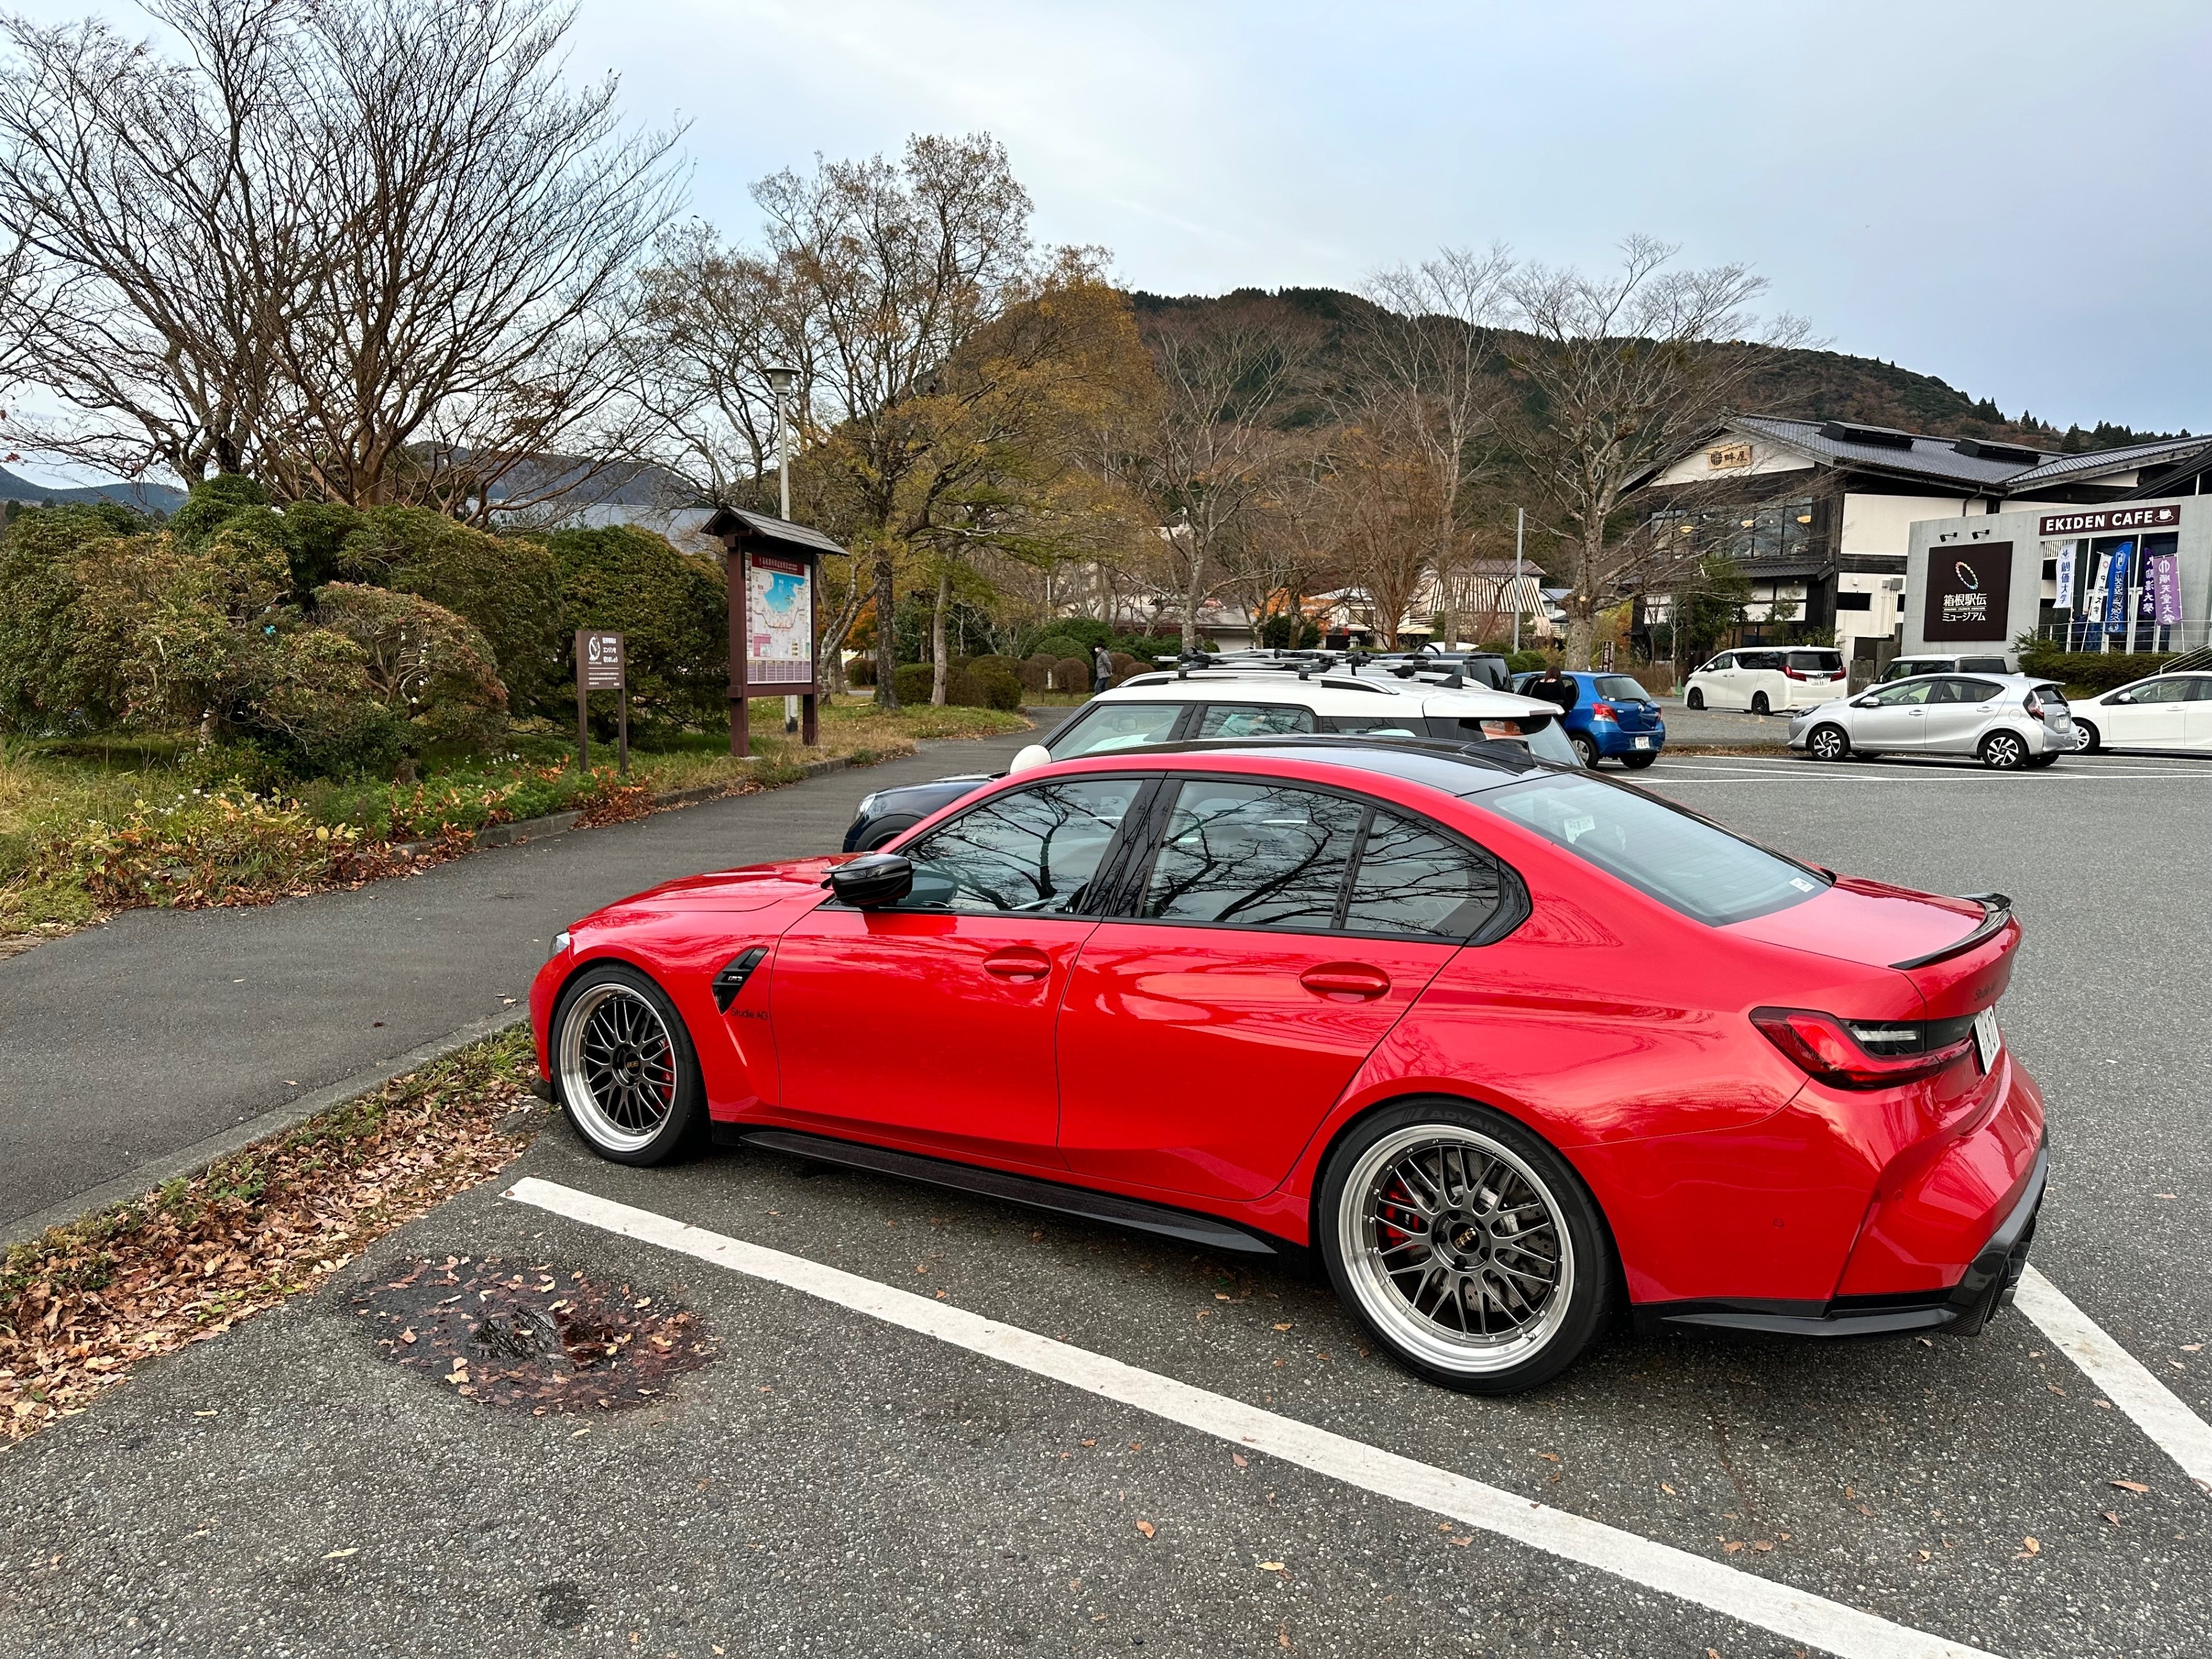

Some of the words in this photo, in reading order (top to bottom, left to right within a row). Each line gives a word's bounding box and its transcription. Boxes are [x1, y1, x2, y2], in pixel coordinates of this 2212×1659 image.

[2045, 514, 2105, 531] EKIDEN
[2112, 510, 2154, 526] CAFE
[2060, 561, 2071, 604] 創価大学
[1943, 593, 1987, 607] 箱根駅伝
[2093, 575, 2106, 615] 中央大学
[2159, 574, 2175, 623] 順天堂大学
[1942, 612, 1986, 622] ミュージアム
[1429, 1110, 1500, 1134] ADVAN
